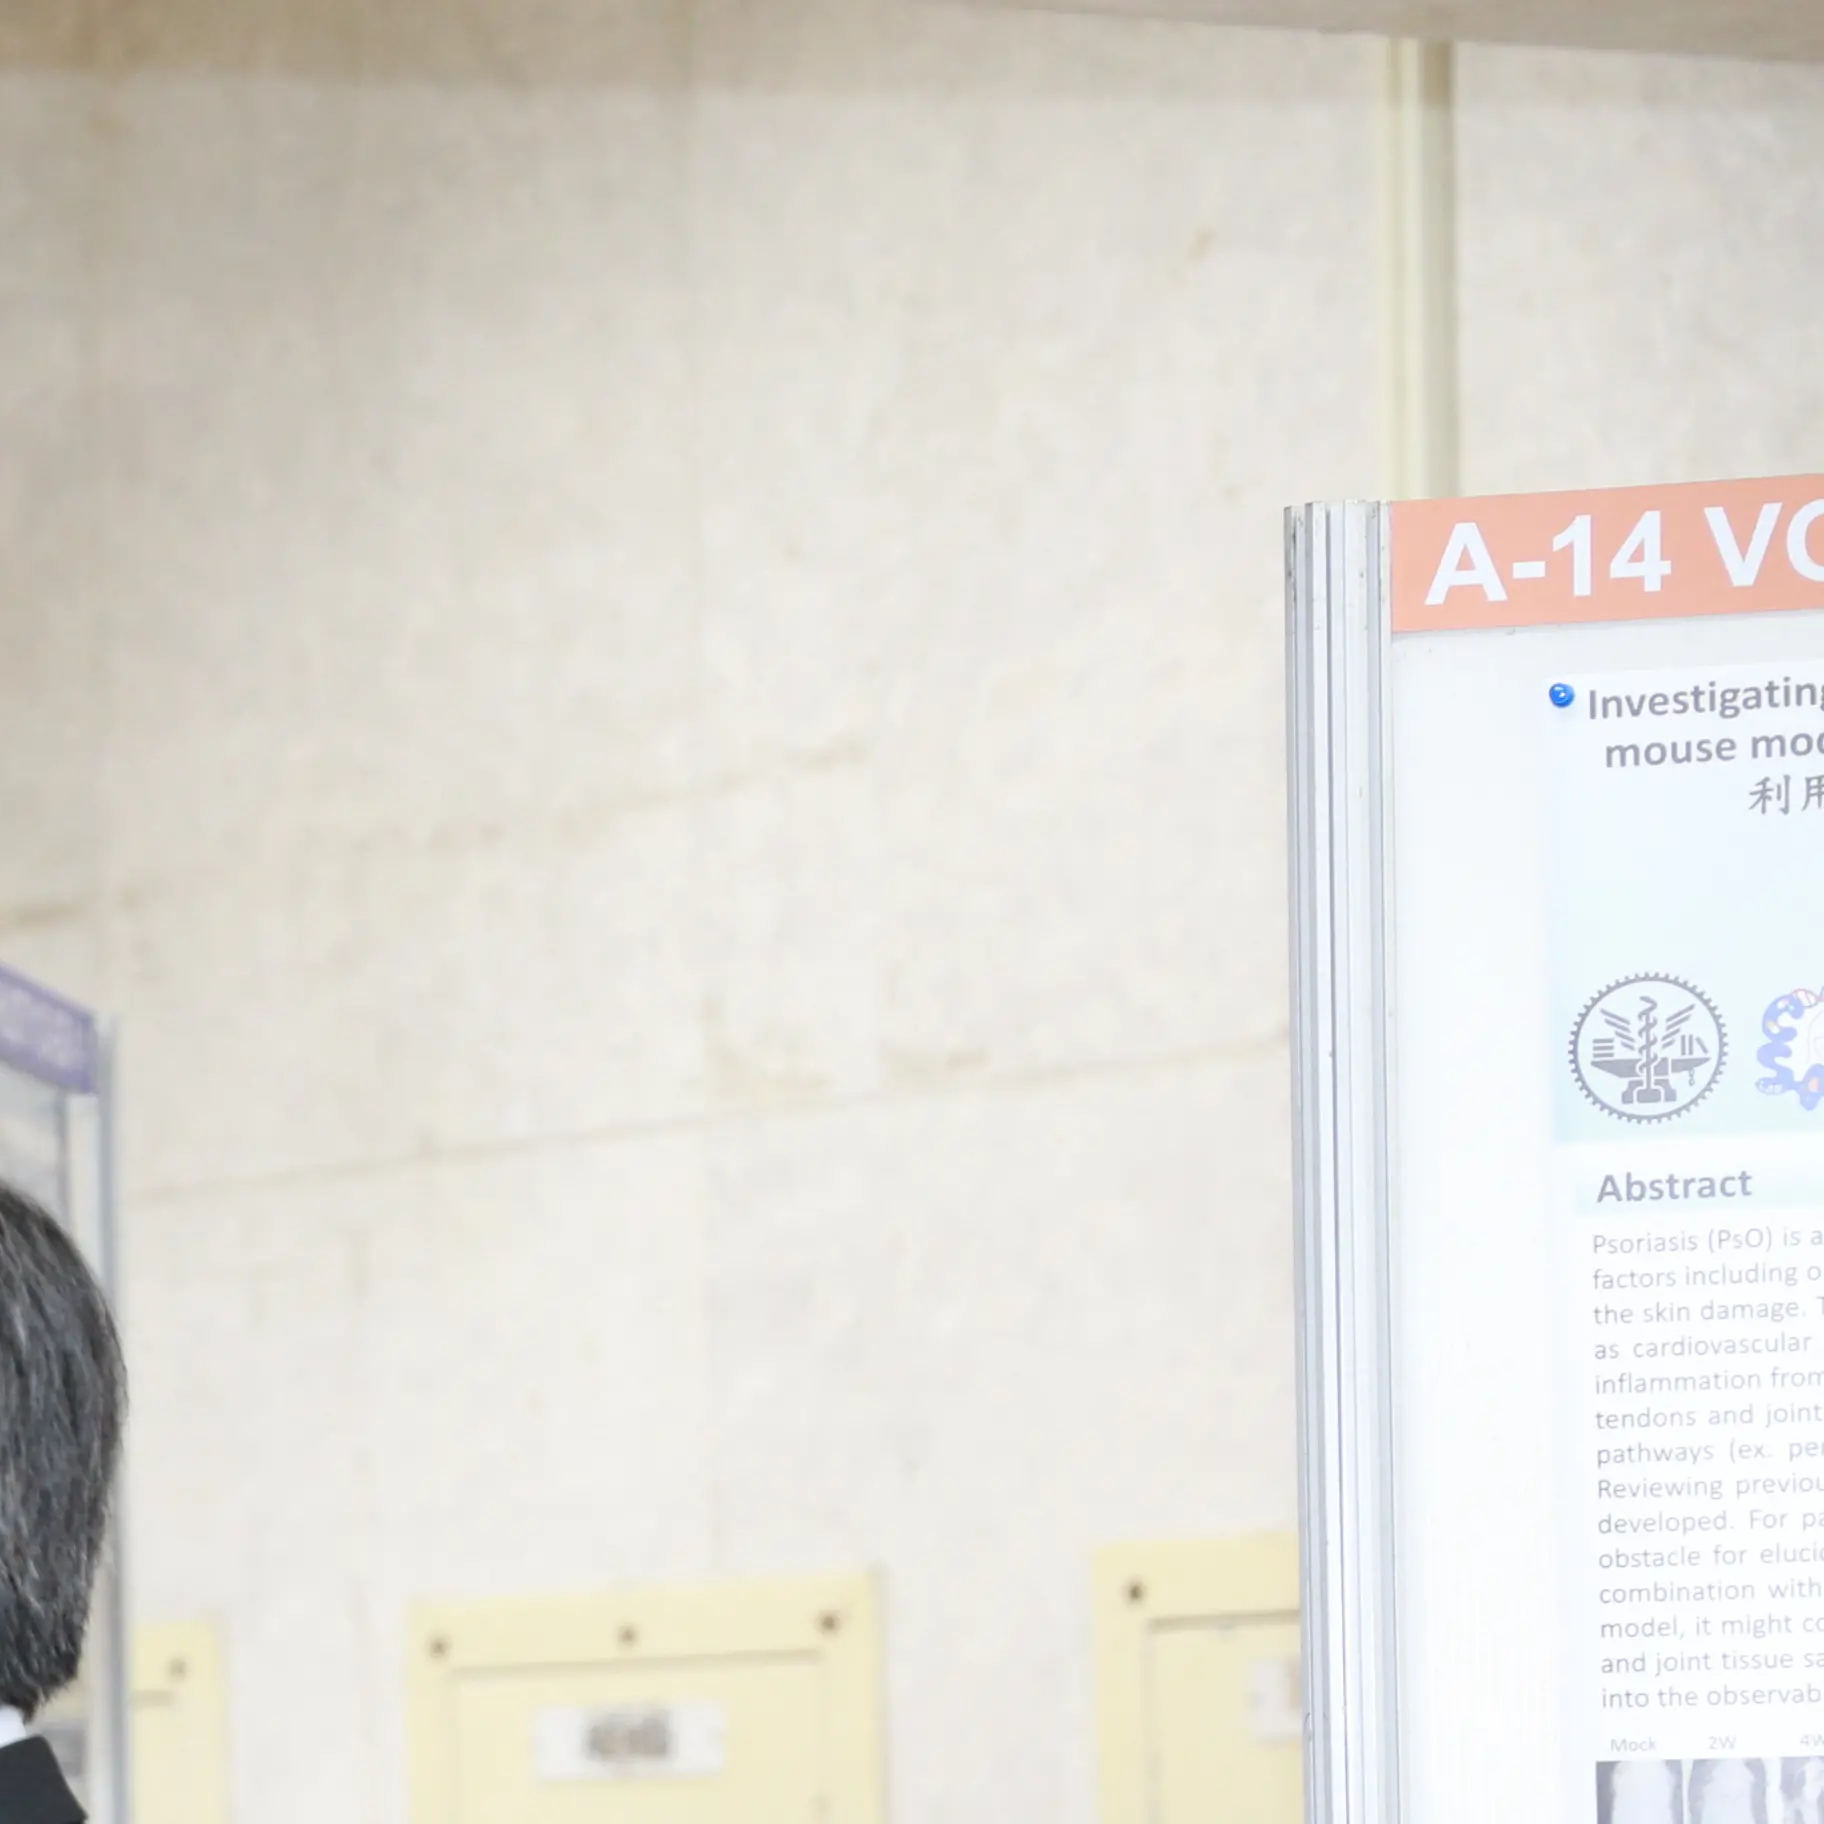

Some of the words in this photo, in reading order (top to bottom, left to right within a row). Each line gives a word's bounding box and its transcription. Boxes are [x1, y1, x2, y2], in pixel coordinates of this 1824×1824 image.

[1424, 510, 1673, 606] A-14
[1589, 677, 1824, 719] Investigatin
[1606, 738, 1736, 768] mouse
[1596, 1171, 1752, 1203] Abstract
[1593, 1231, 1698, 1254] Psoriasis
[1708, 1226, 1772, 1254] (PsO)
[1783, 1227, 1801, 1246] is
[1592, 1268, 1676, 1290] factors
[1686, 1262, 1798, 1287] including
[1593, 1304, 1633, 1325] the
[1643, 1301, 1690, 1323] skin
[1701, 1300, 1806, 1322] damage.
[1595, 1344, 1619, 1360] as
[1633, 1331, 1812, 1357] cardiovascular
[1596, 1370, 1761, 1394] inflammation
[1771, 1366, 1824, 1388] from
[1594, 1407, 1696, 1429] tendons
[1708, 1403, 1753, 1425] and
[1765, 1402, 1823, 1428] joint
[1597, 1442, 1714, 1469] pathways
[1598, 1477, 1723, 1500] Reviewing
[1598, 1510, 1734, 1536] developed.
[1749, 1509, 1788, 1529] For
[1599, 1546, 1700, 1569] obstacle
[1713, 1544, 1748, 1565] for
[1600, 1581, 1754, 1603] combination
[1768, 1577, 1822, 1598] with
[1601, 1614, 1684, 1640] model,
[1696, 1616, 1712, 1636] it
[1722, 1613, 1792, 1639] might
[1601, 1652, 1645, 1673] and
[1655, 1652, 1712, 1677] joint
[1721, 1651, 1793, 1670] tissue
[1602, 1688, 1649, 1708] into
[1657, 1686, 1698, 1707] the
[1610, 1737, 1657, 1752] Mock
